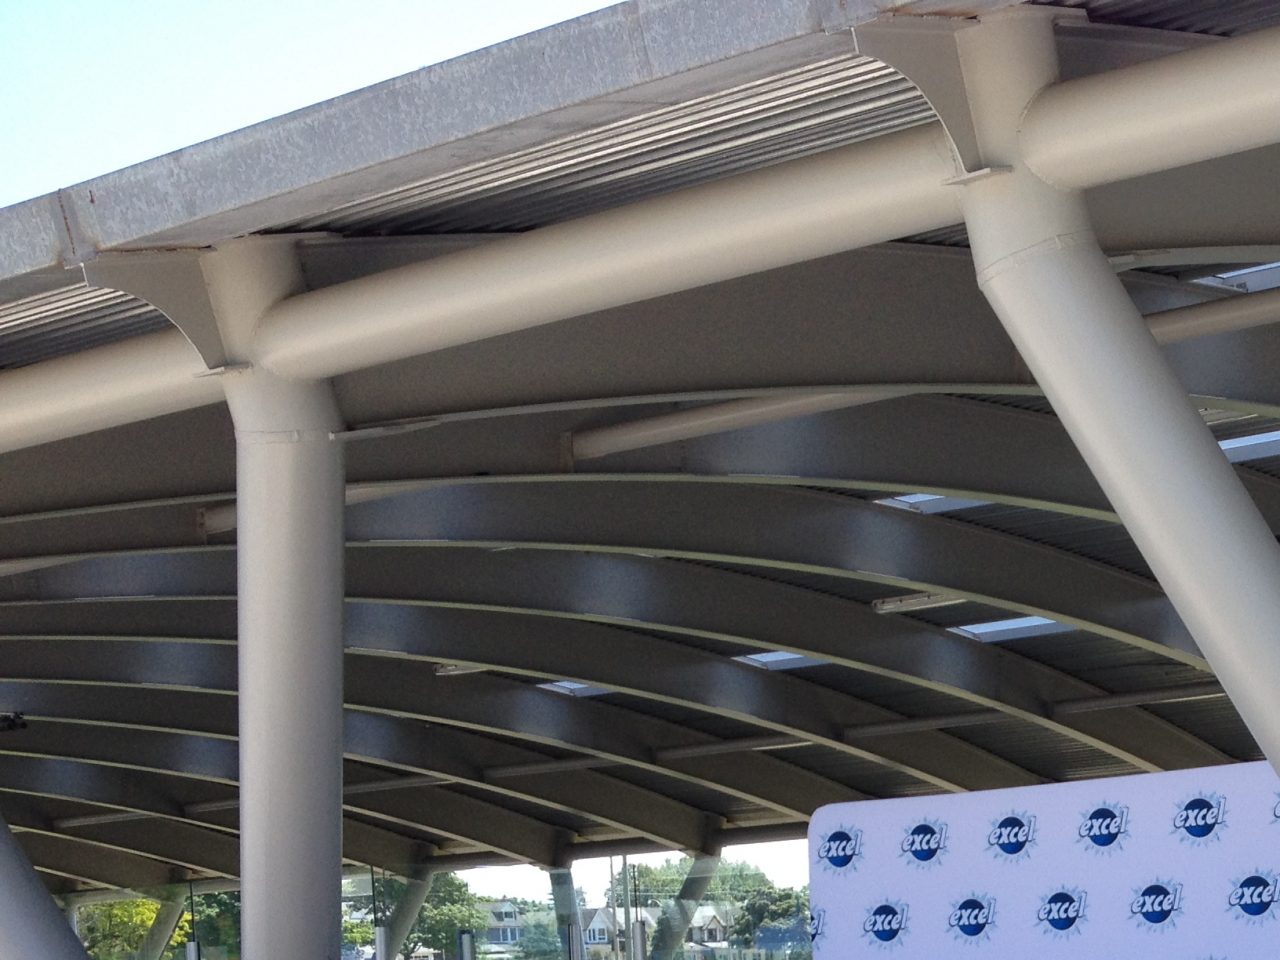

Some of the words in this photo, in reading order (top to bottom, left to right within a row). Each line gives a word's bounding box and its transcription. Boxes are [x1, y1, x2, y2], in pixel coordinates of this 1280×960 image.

[1079, 808, 1129, 839] excel
[1174, 798, 1227, 828] excel
[818, 831, 862, 858] excel
[902, 826, 949, 851] excel
[989, 817, 1037, 844] excel
[949, 897, 996, 927] excel
[1038, 892, 1087, 920] excel
[1131, 885, 1183, 913] excel
[864, 905, 909, 933] excel
